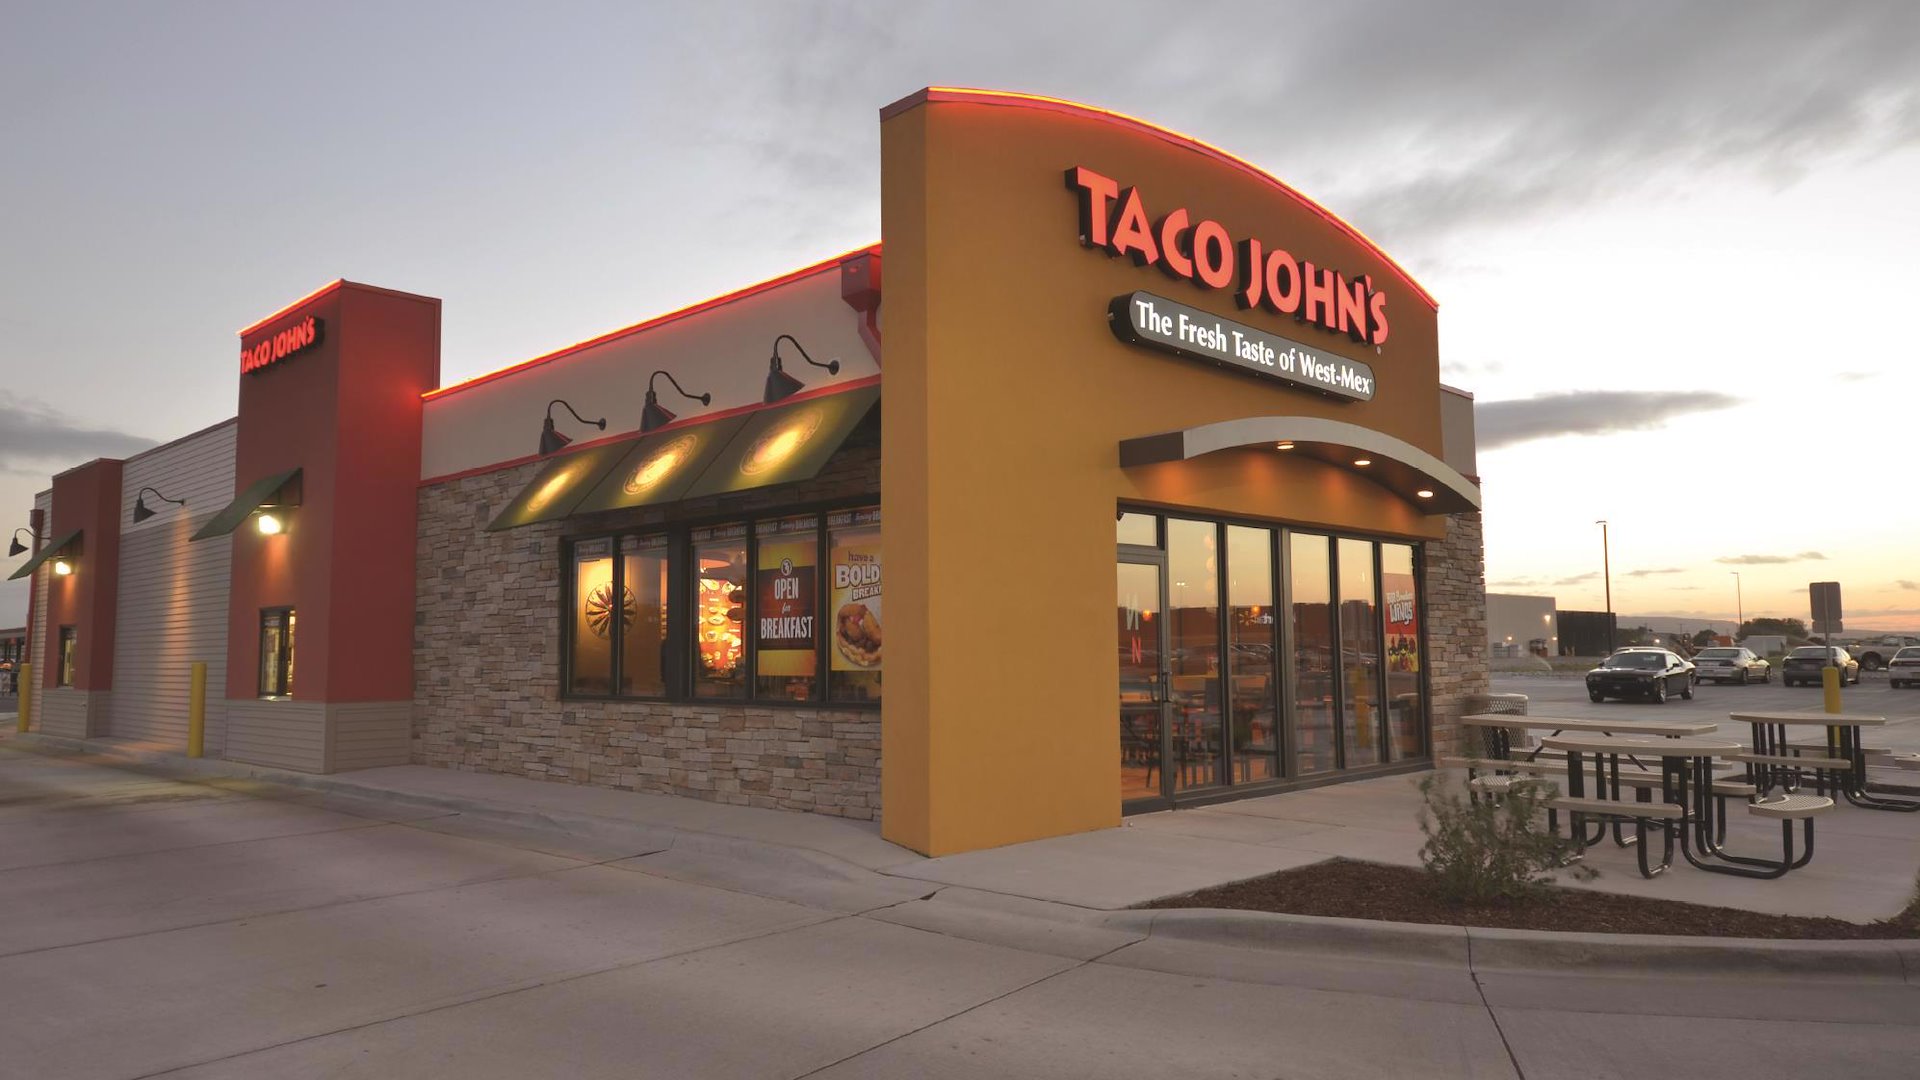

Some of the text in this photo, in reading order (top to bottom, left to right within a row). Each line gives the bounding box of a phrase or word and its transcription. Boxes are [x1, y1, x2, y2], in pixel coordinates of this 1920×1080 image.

[1076, 165, 1390, 345] TACO JOHN'S
[241, 315, 316, 375] TACO JOHN'S
[1135, 300, 1172, 336] The
[1178, 314, 1227, 353] Fresh
[1232, 331, 1275, 367] Taste
[1279, 345, 1297, 373] of
[774, 577, 799, 599] OPEN
[836, 564, 881, 589] BOLD
[782, 602, 791, 614] for
[760, 616, 814, 639] BREAKFAST
